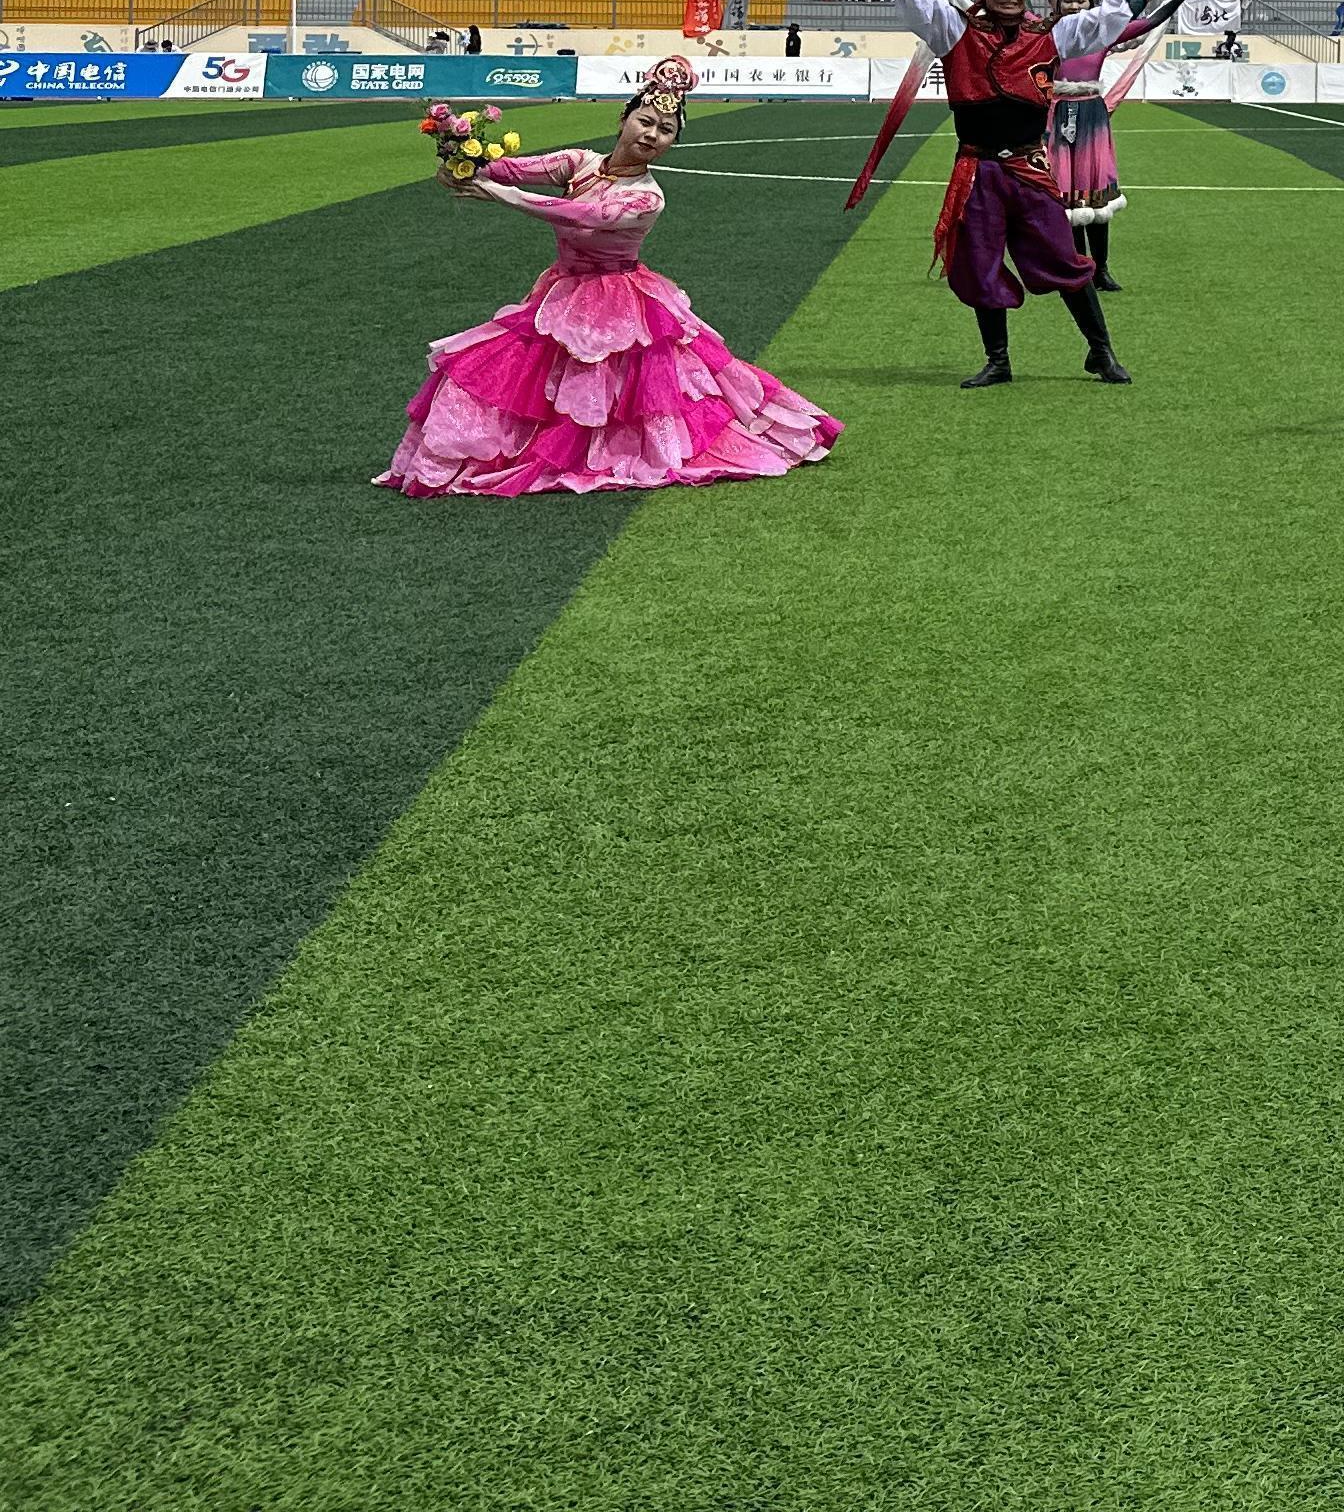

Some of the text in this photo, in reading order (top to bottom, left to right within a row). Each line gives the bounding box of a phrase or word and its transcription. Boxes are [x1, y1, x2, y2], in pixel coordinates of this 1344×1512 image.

[27, 60, 128, 83] 中国电信
[202, 56, 250, 83] 5G
[352, 63, 425, 81] 国家电网
[701, 68, 834, 84] 中国农业银行
[25, 82, 126, 90] CHINA TELECOM
[350, 80, 424, 90] STATE GRID
